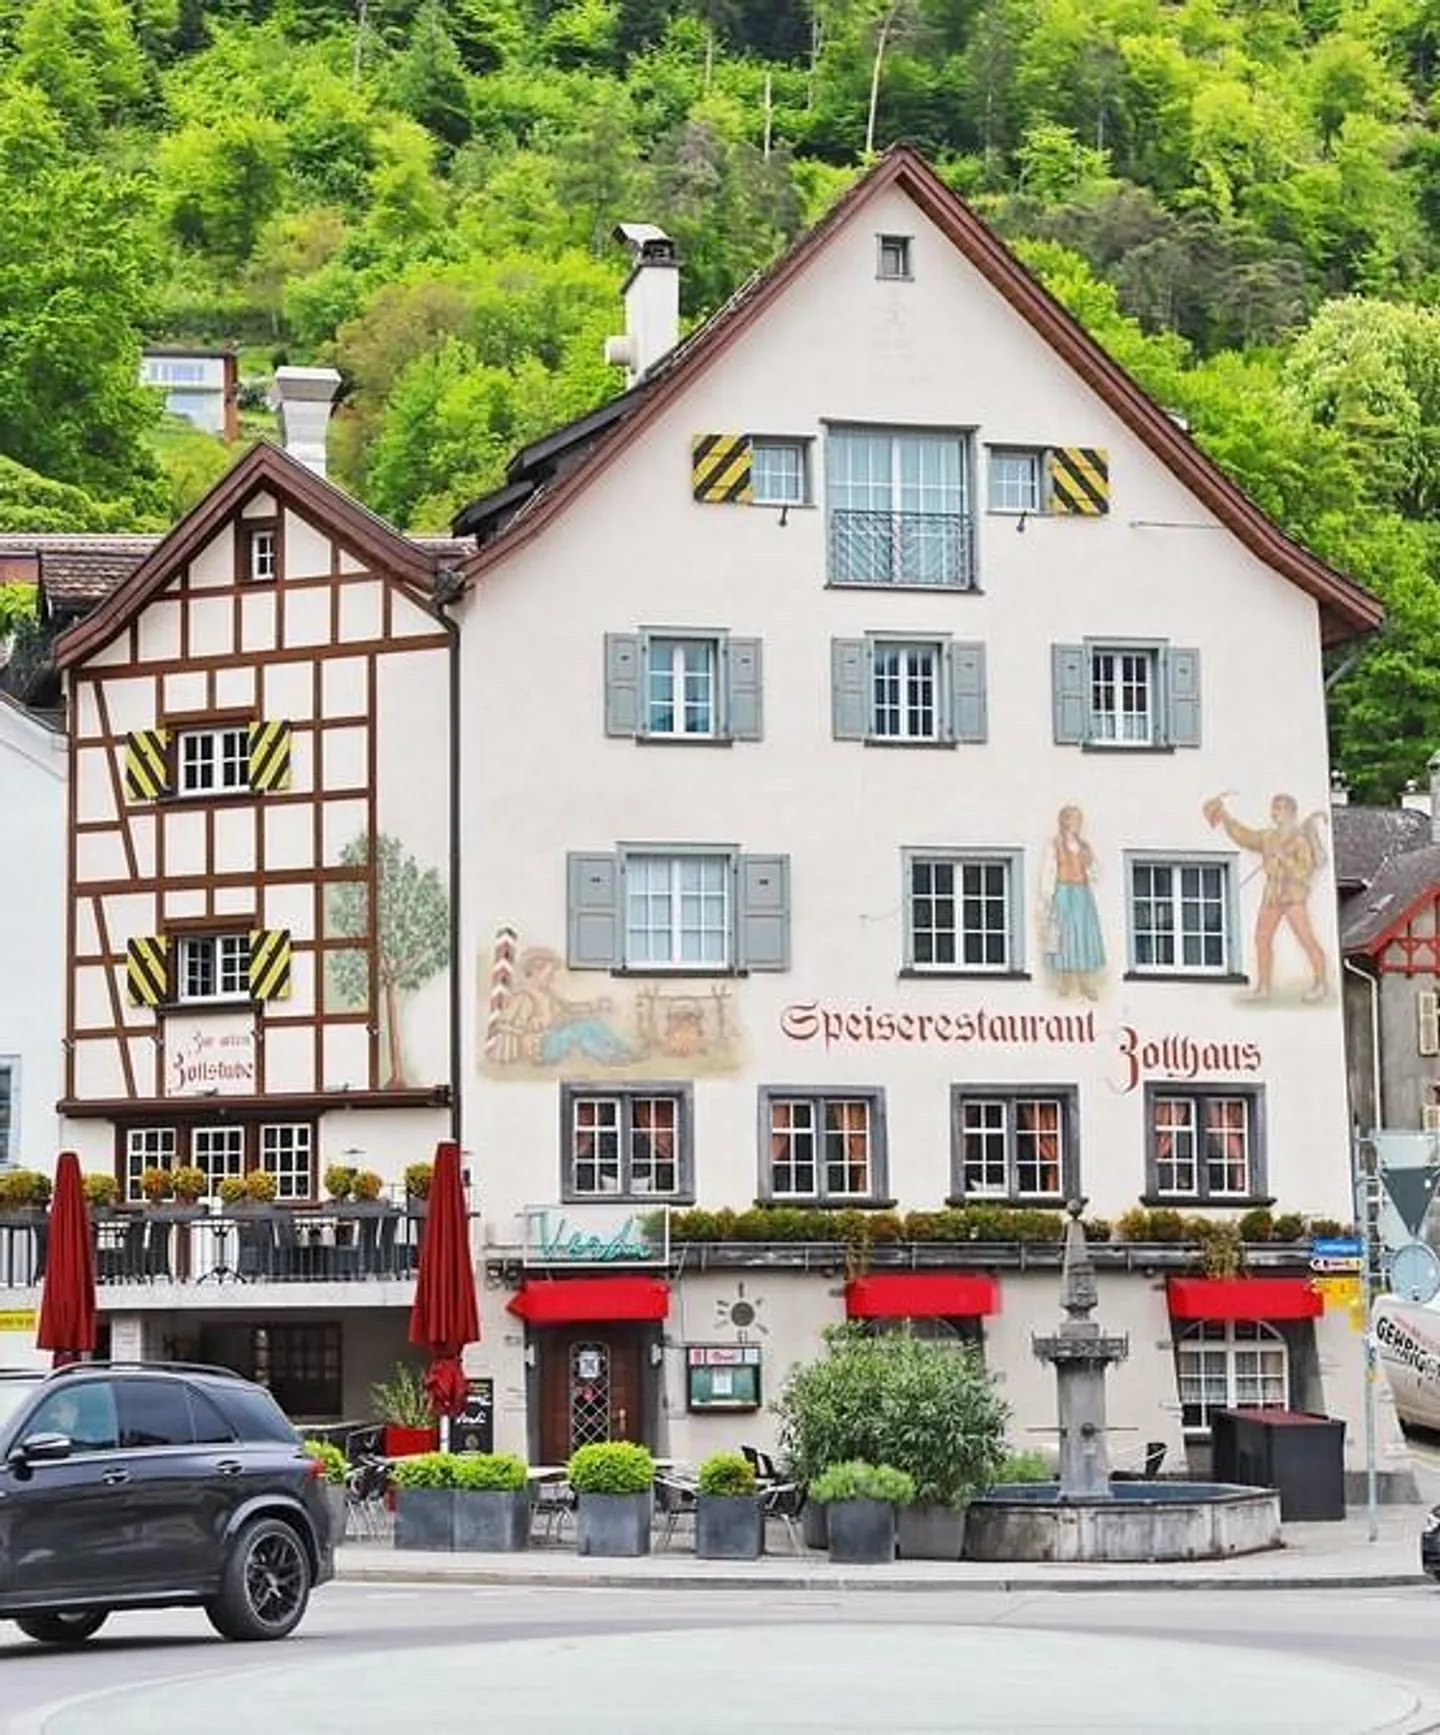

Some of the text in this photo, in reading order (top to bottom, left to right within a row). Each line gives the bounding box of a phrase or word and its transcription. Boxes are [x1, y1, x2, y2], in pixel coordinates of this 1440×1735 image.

[780, 1002, 1096, 1050] Speiserestaurant
[1114, 1026, 1262, 1093] Zollhaus
[1376, 1317, 1429, 1374] GEHRIG
